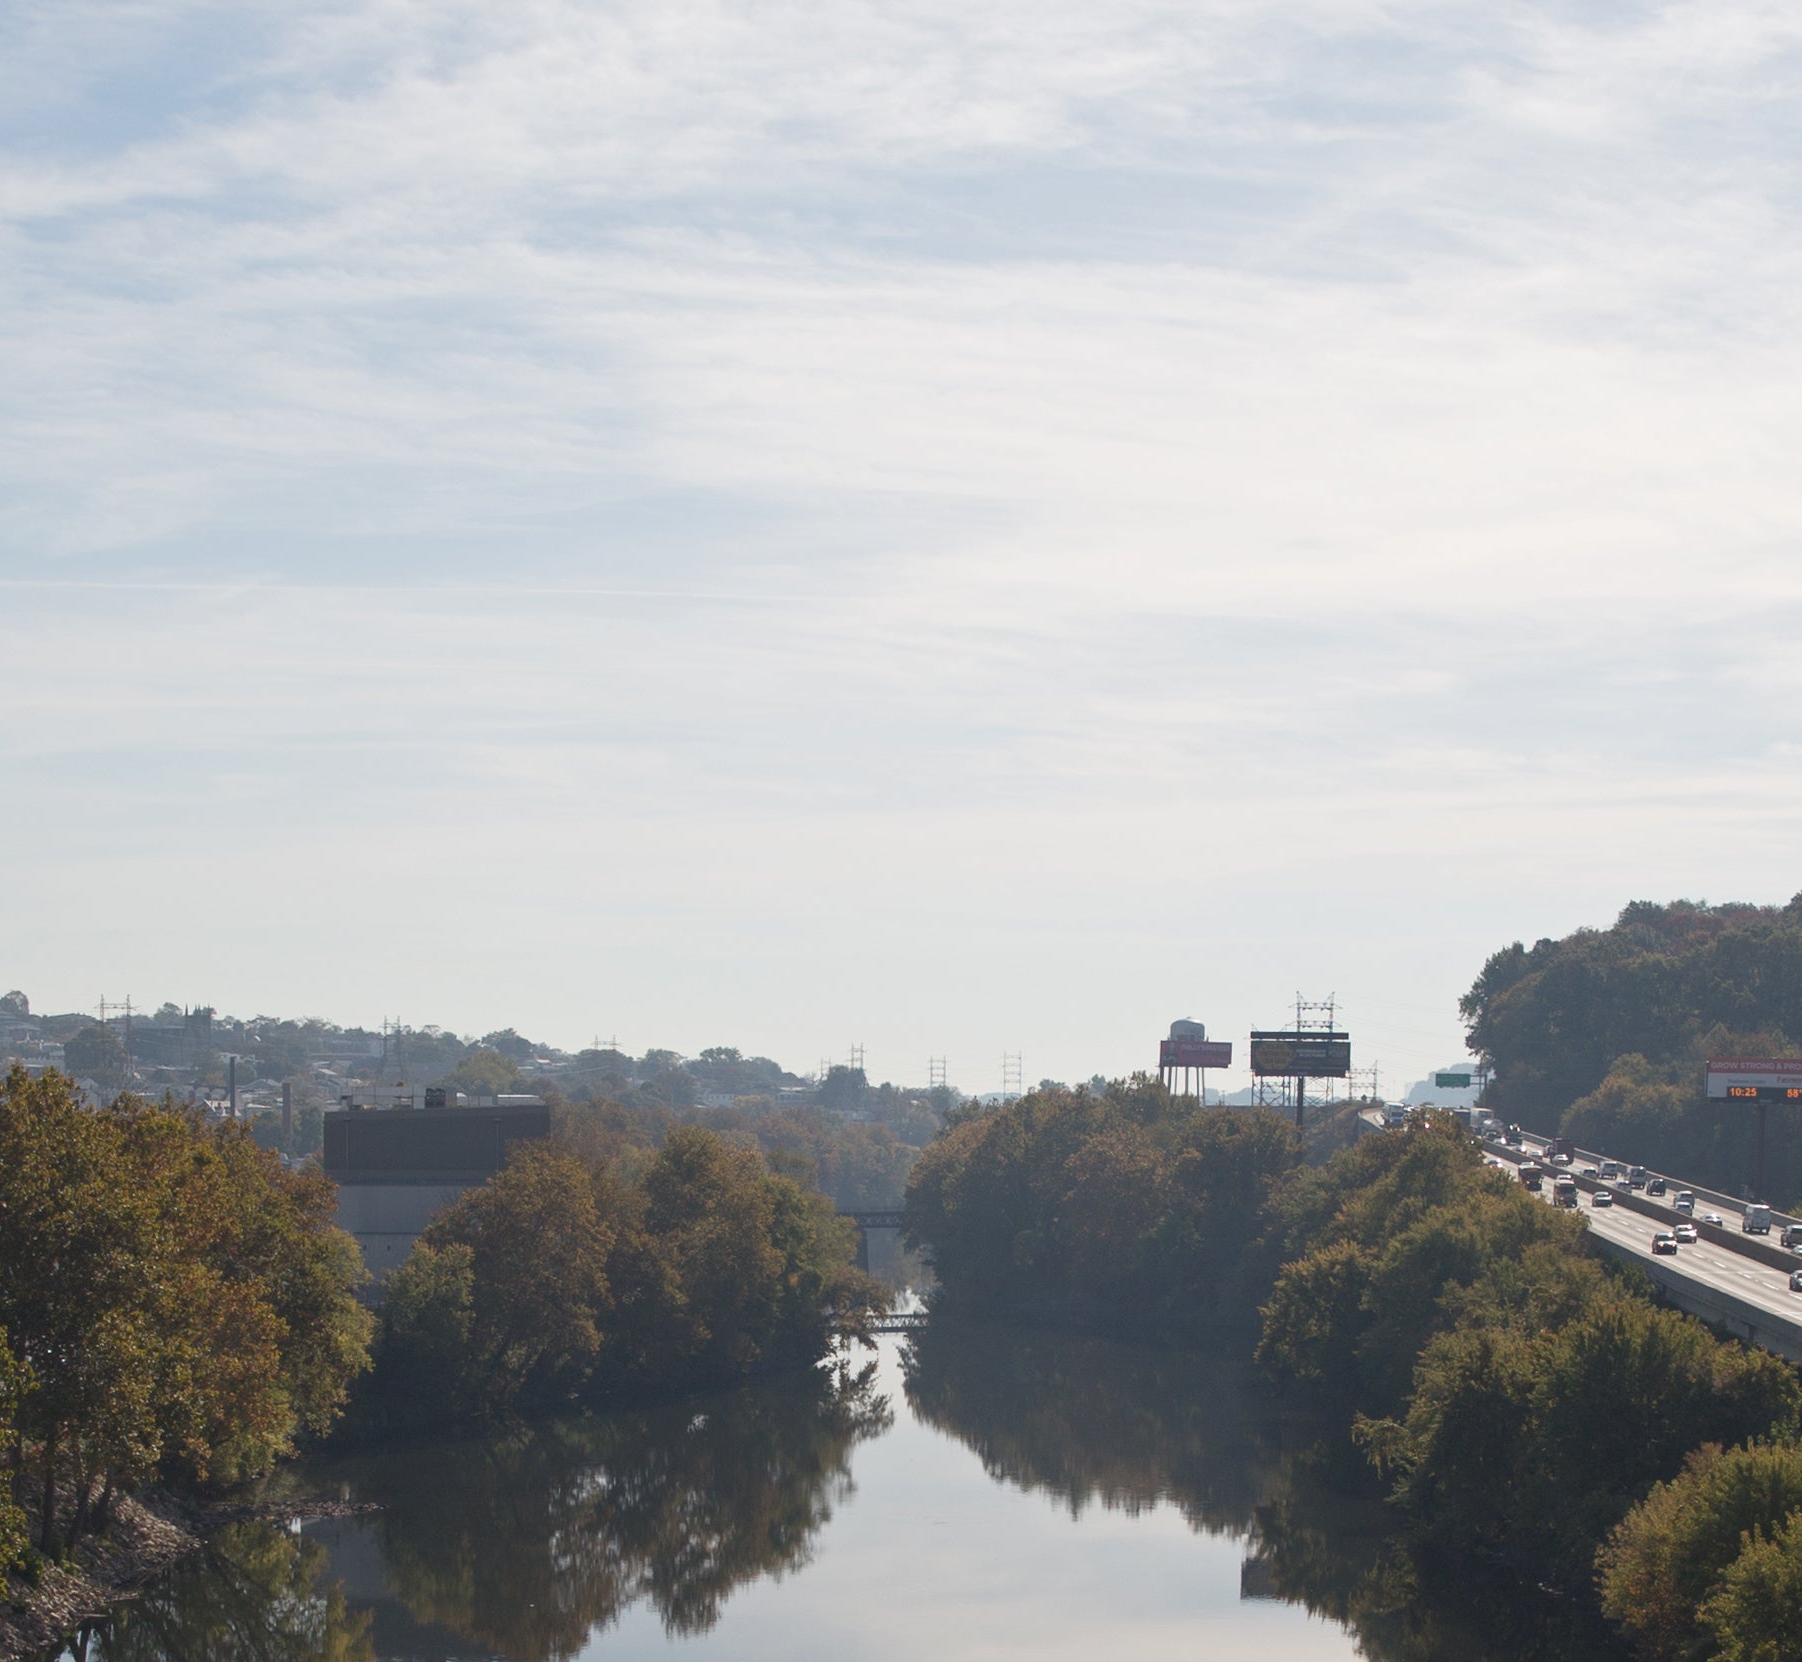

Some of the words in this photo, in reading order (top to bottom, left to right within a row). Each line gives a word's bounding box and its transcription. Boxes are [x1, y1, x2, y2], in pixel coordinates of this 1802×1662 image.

[1710, 1061, 1739, 1069] GROW
[1740, 1062, 1775, 1070] STRONG
[1729, 1087, 1758, 1097] 10:25
